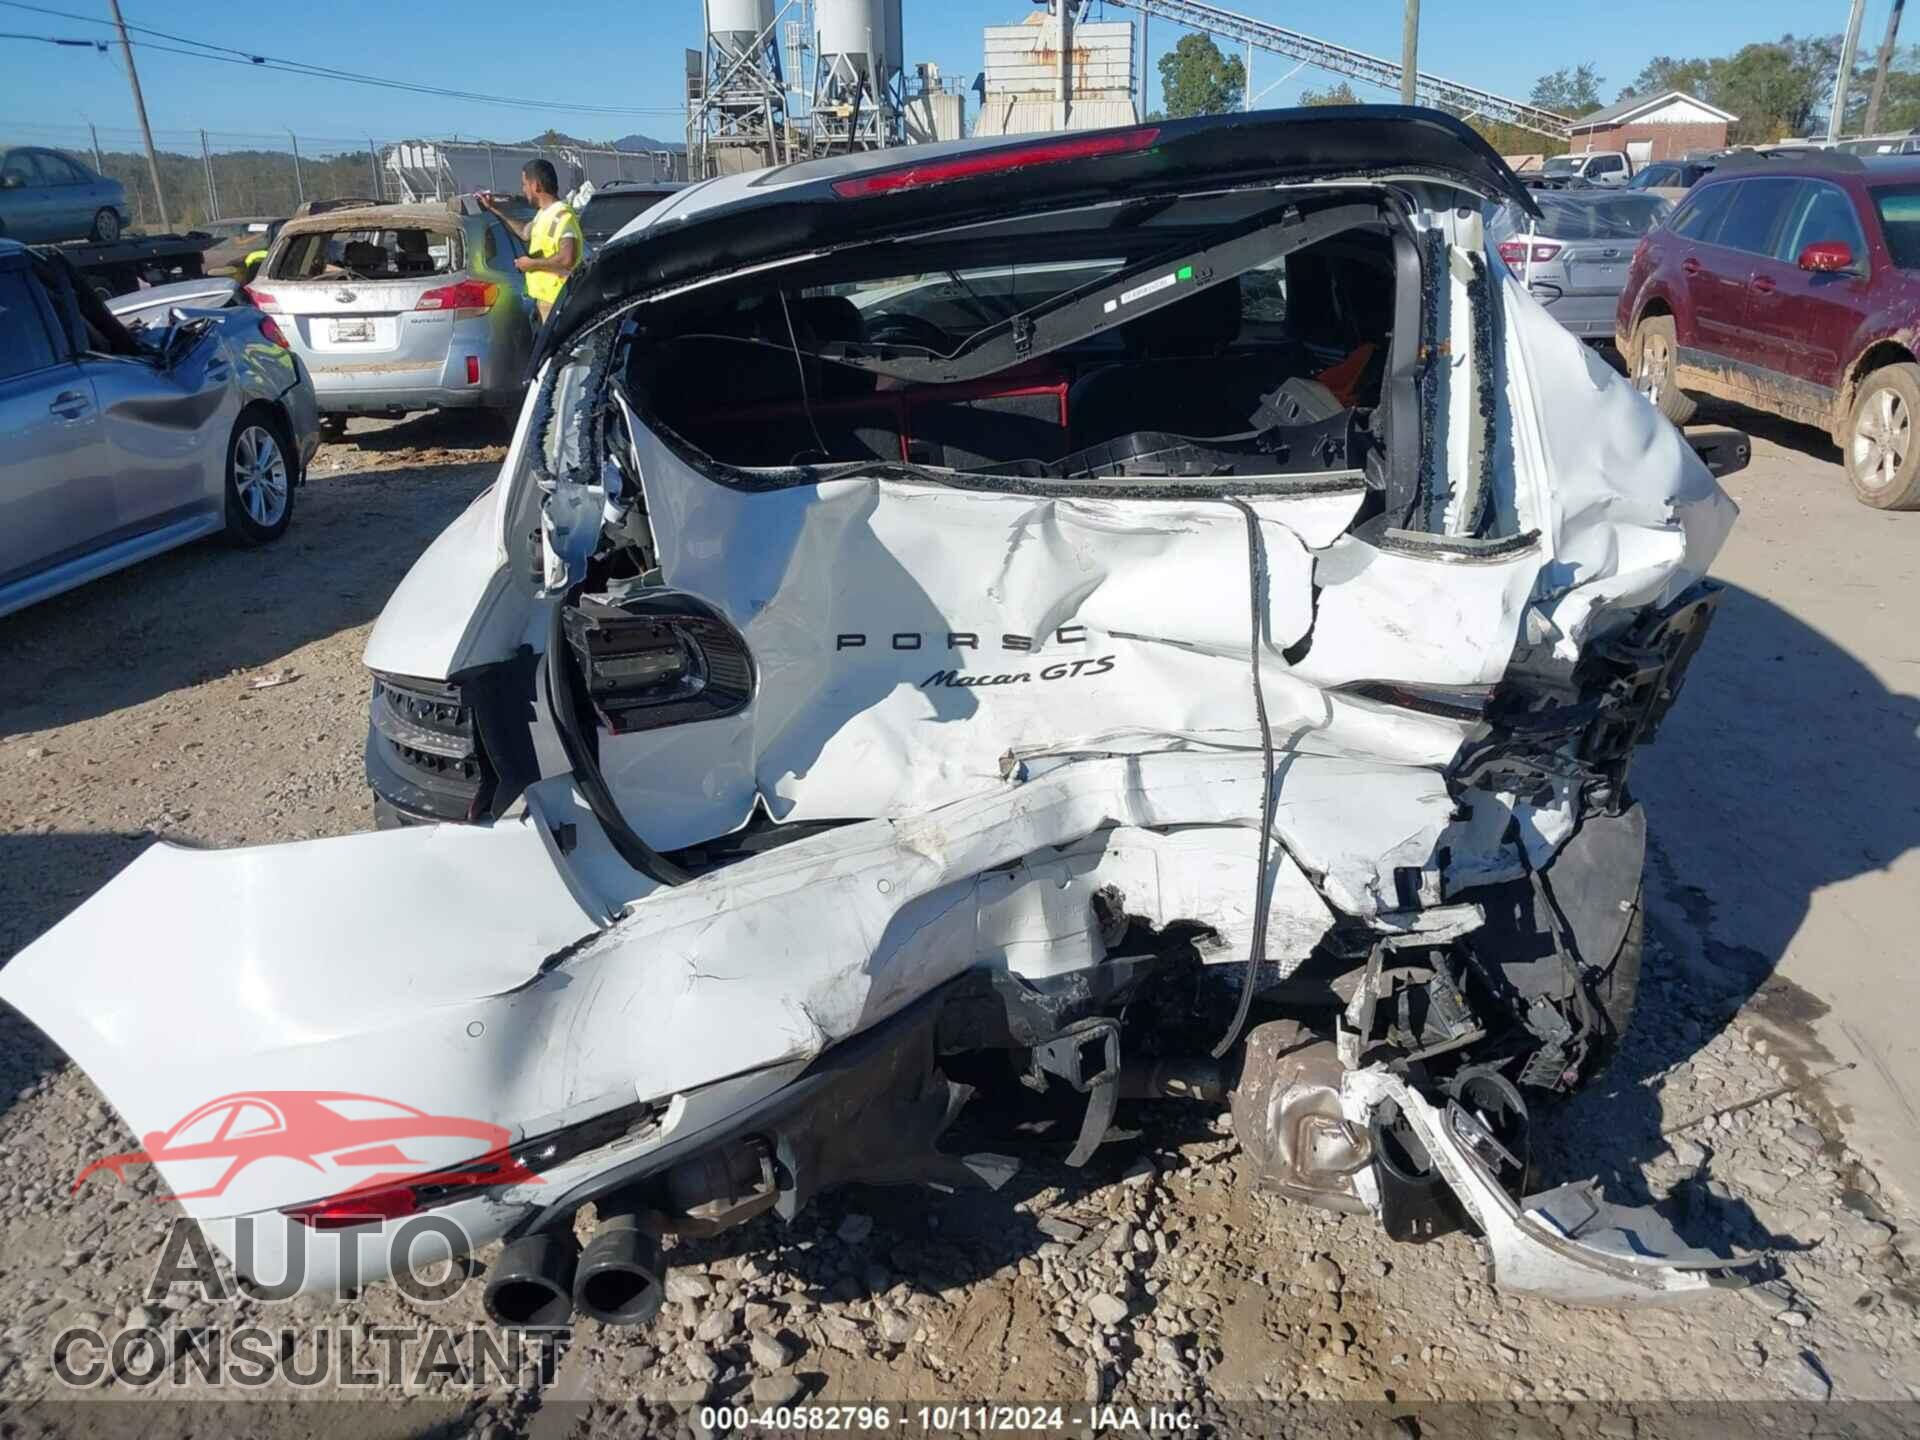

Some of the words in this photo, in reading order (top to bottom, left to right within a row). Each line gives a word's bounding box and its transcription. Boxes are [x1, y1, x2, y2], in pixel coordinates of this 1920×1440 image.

[836, 625, 1194, 652] PORSC
[920, 670, 1032, 688] Macan
[1040, 655, 1116, 681] GTS
